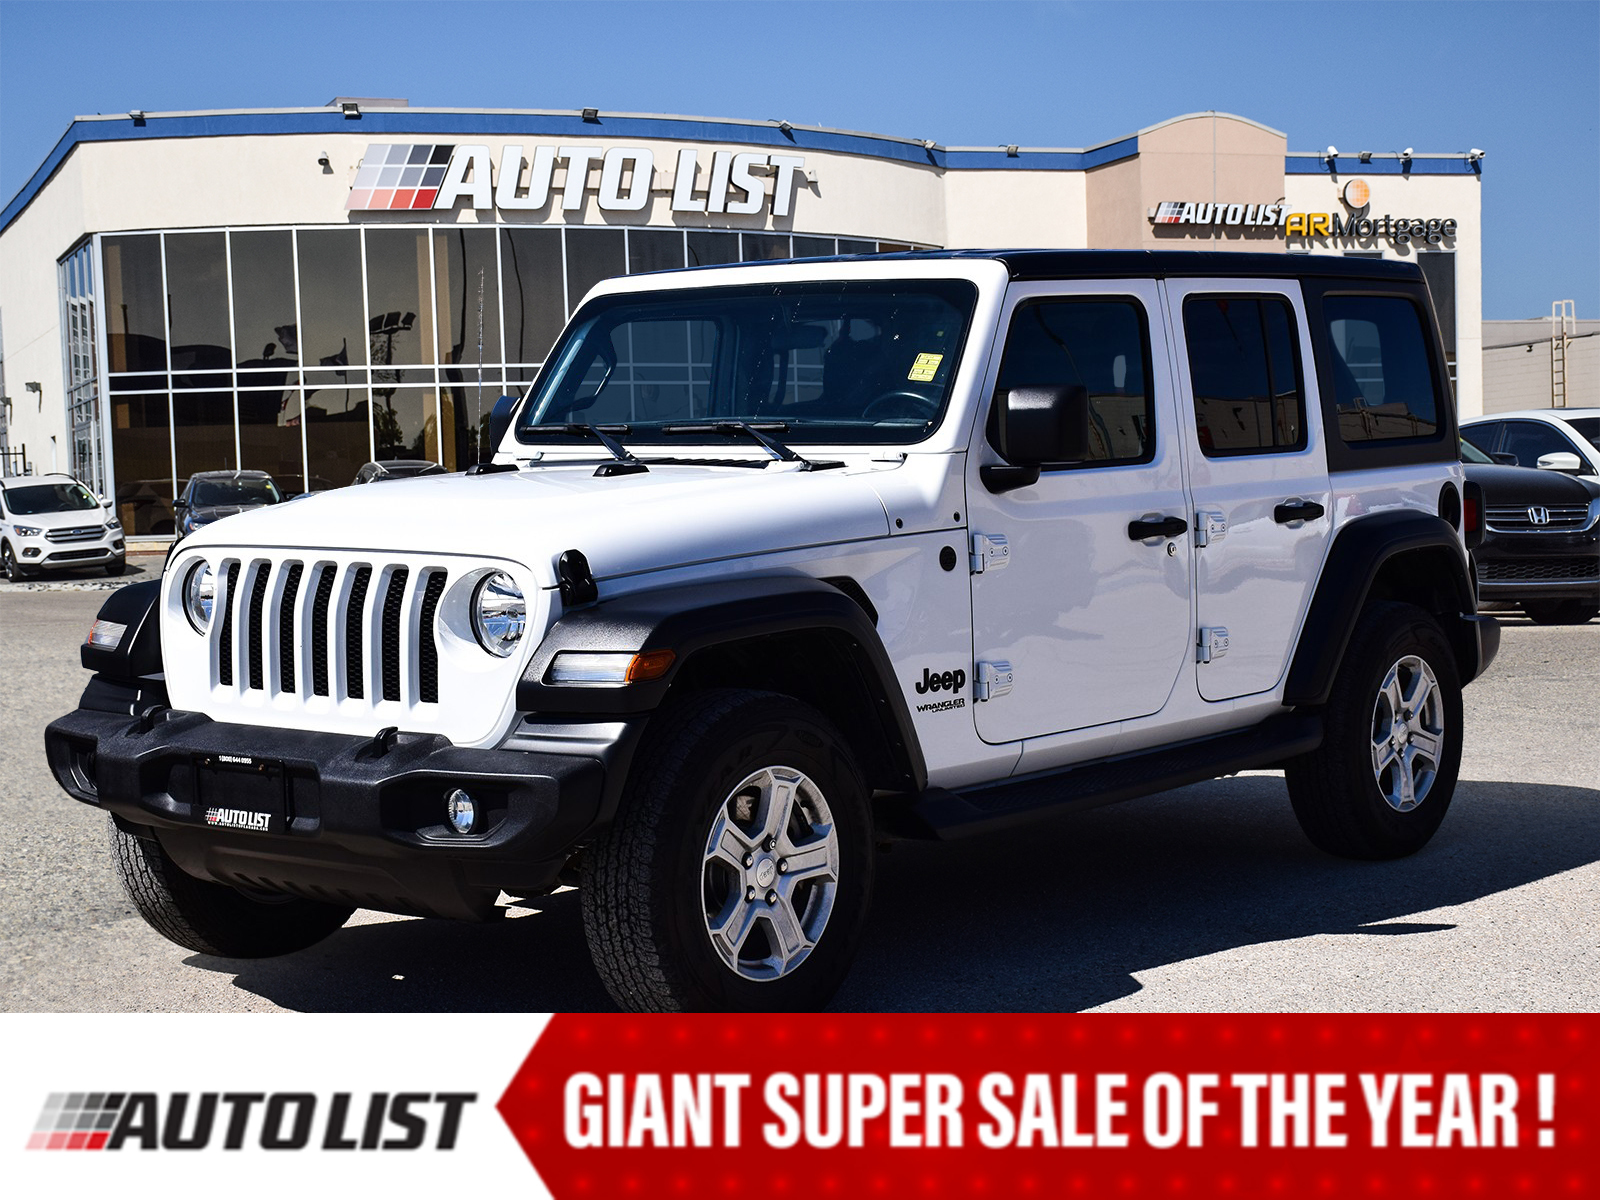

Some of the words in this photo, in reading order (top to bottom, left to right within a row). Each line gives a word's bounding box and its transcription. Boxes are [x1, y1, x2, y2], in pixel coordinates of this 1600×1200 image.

[434, 145, 654, 211] AUTO
[672, 149, 805, 216] LIST
[1179, 202, 1245, 225] AUTO
[1243, 203, 1292, 226] LIST
[1332, 212, 1458, 245] Mortgage
[915, 667, 966, 694] Jeep
[916, 697, 966, 713] WRANGLER
